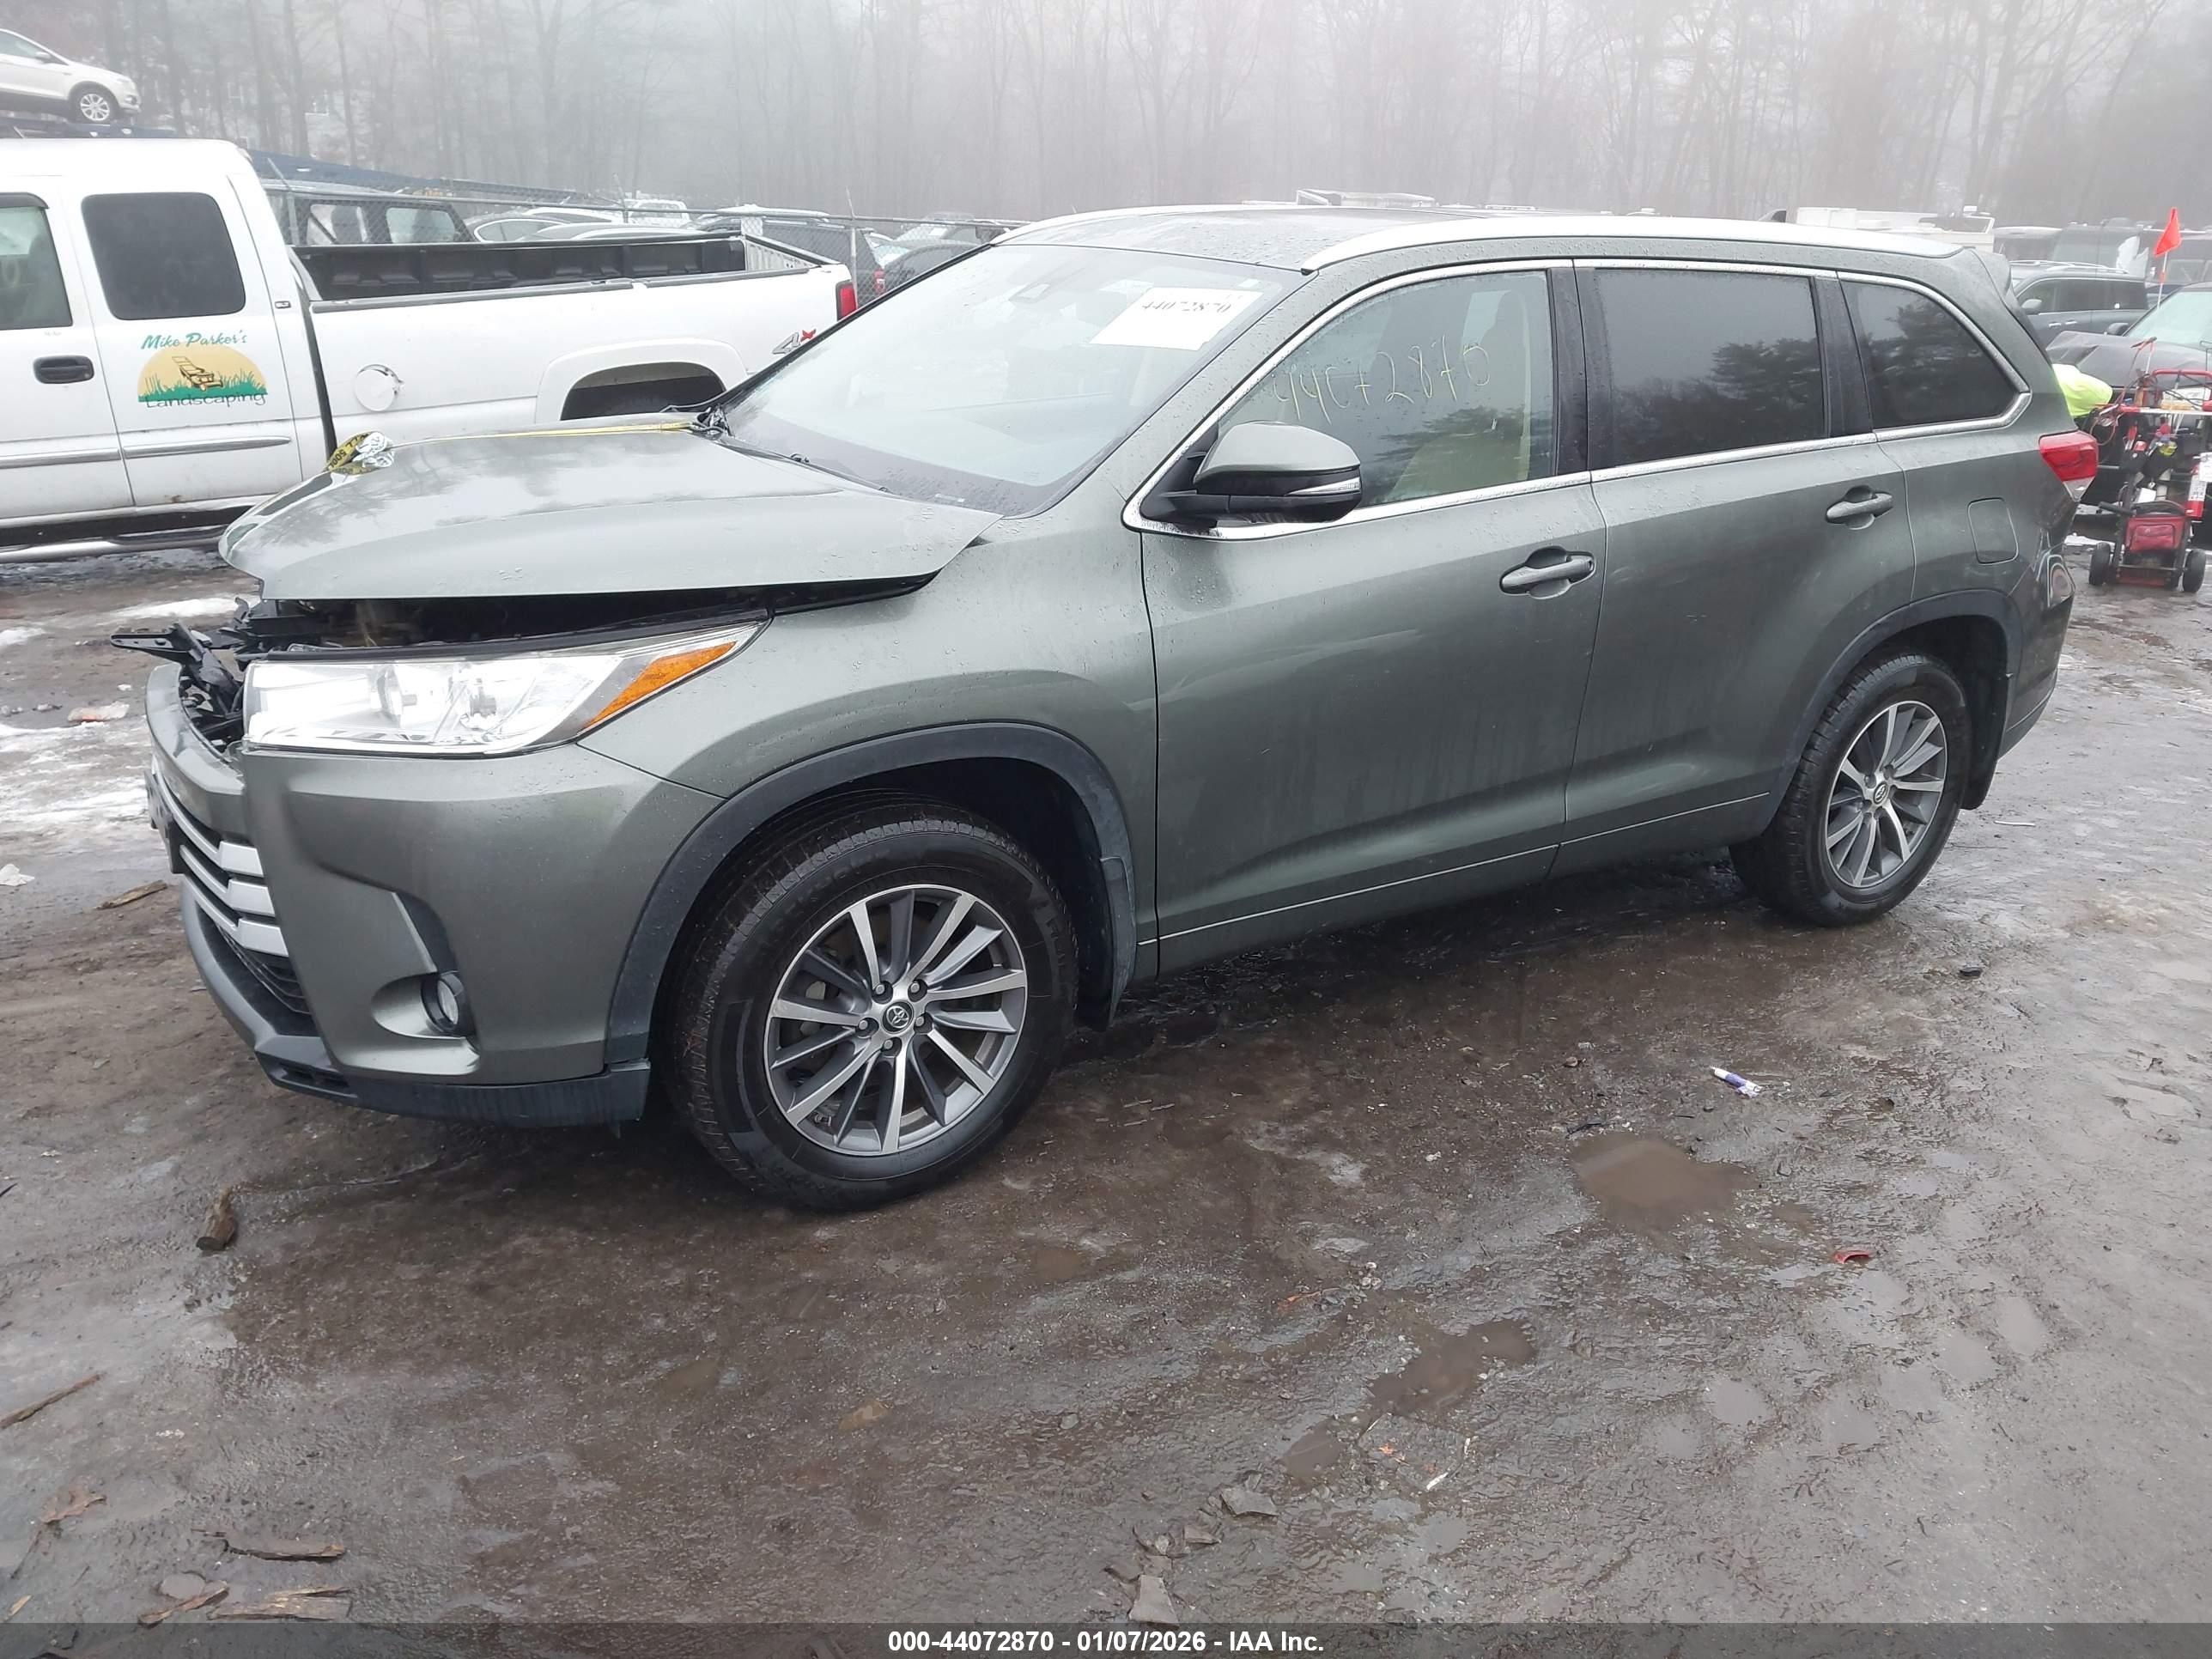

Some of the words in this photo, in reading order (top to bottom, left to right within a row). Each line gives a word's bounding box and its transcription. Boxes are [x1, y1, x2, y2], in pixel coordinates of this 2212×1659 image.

[141, 334, 180, 349] Mike
[185, 330, 247, 348] Parker's
[144, 392, 267, 409] Landscaping
